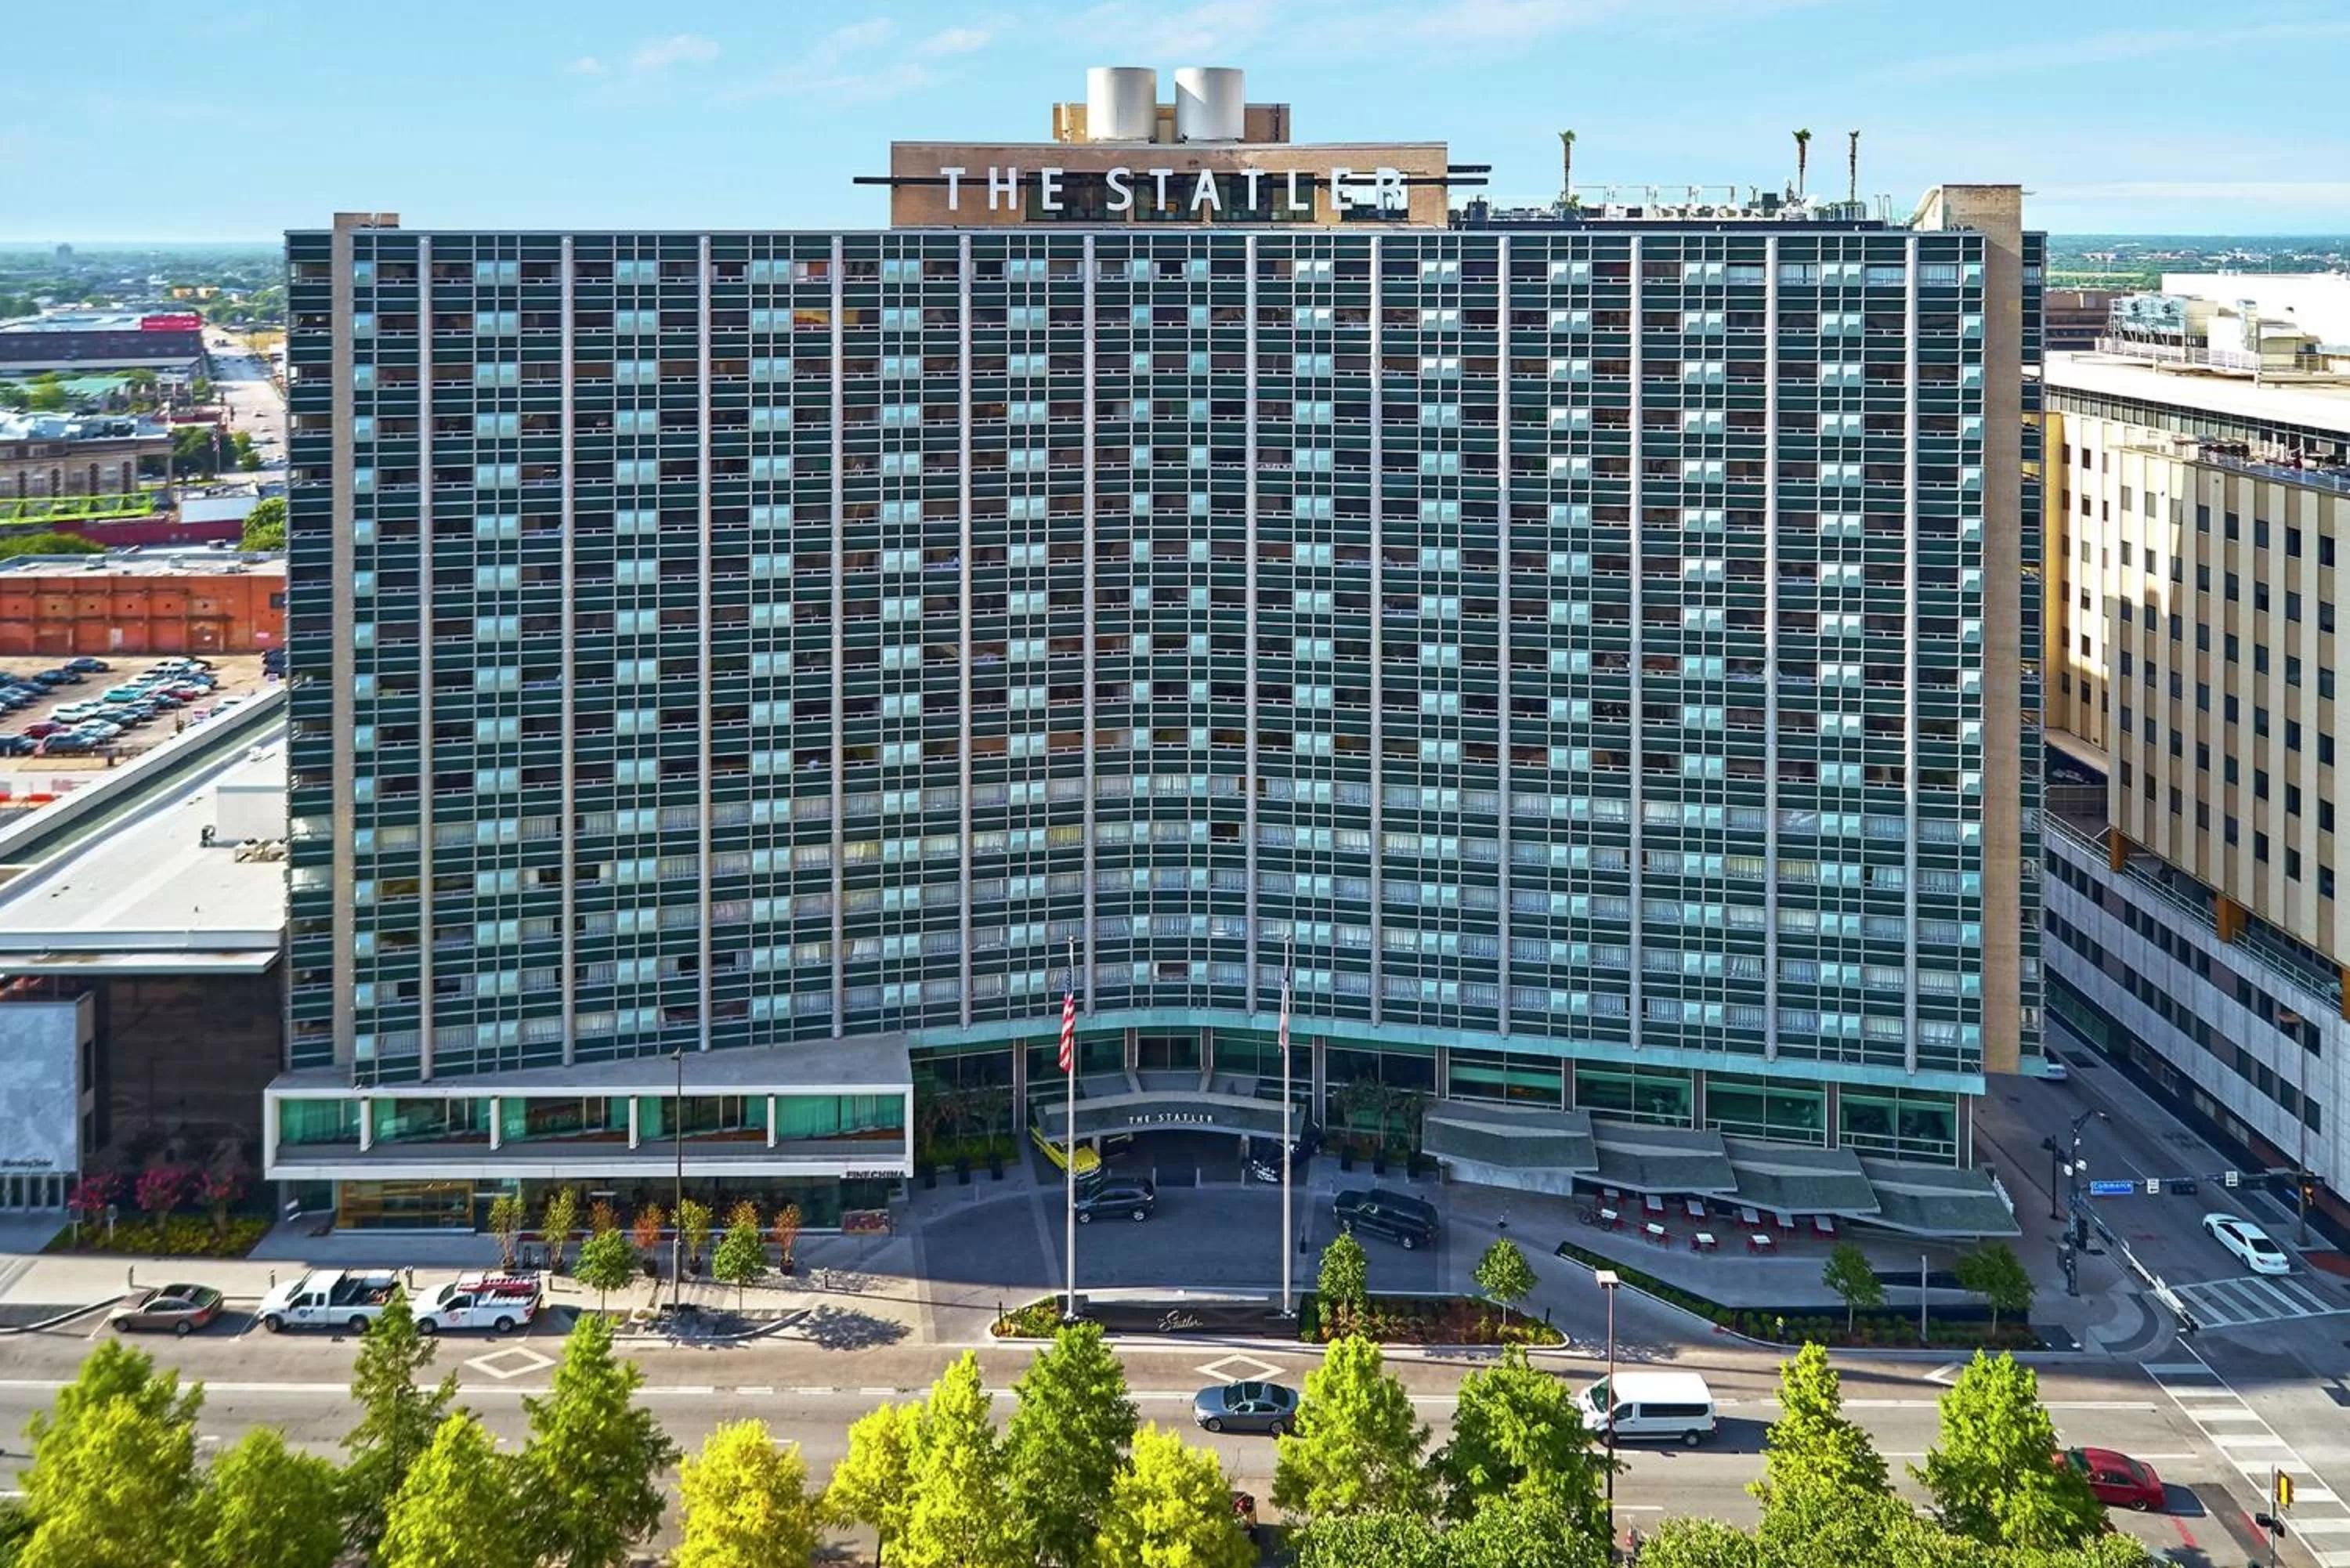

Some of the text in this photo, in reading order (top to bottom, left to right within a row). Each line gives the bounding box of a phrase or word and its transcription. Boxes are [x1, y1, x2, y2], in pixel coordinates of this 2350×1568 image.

[940, 167, 1401, 211] THE STATLER
[1129, 1113, 1213, 1125] THE STATLER
